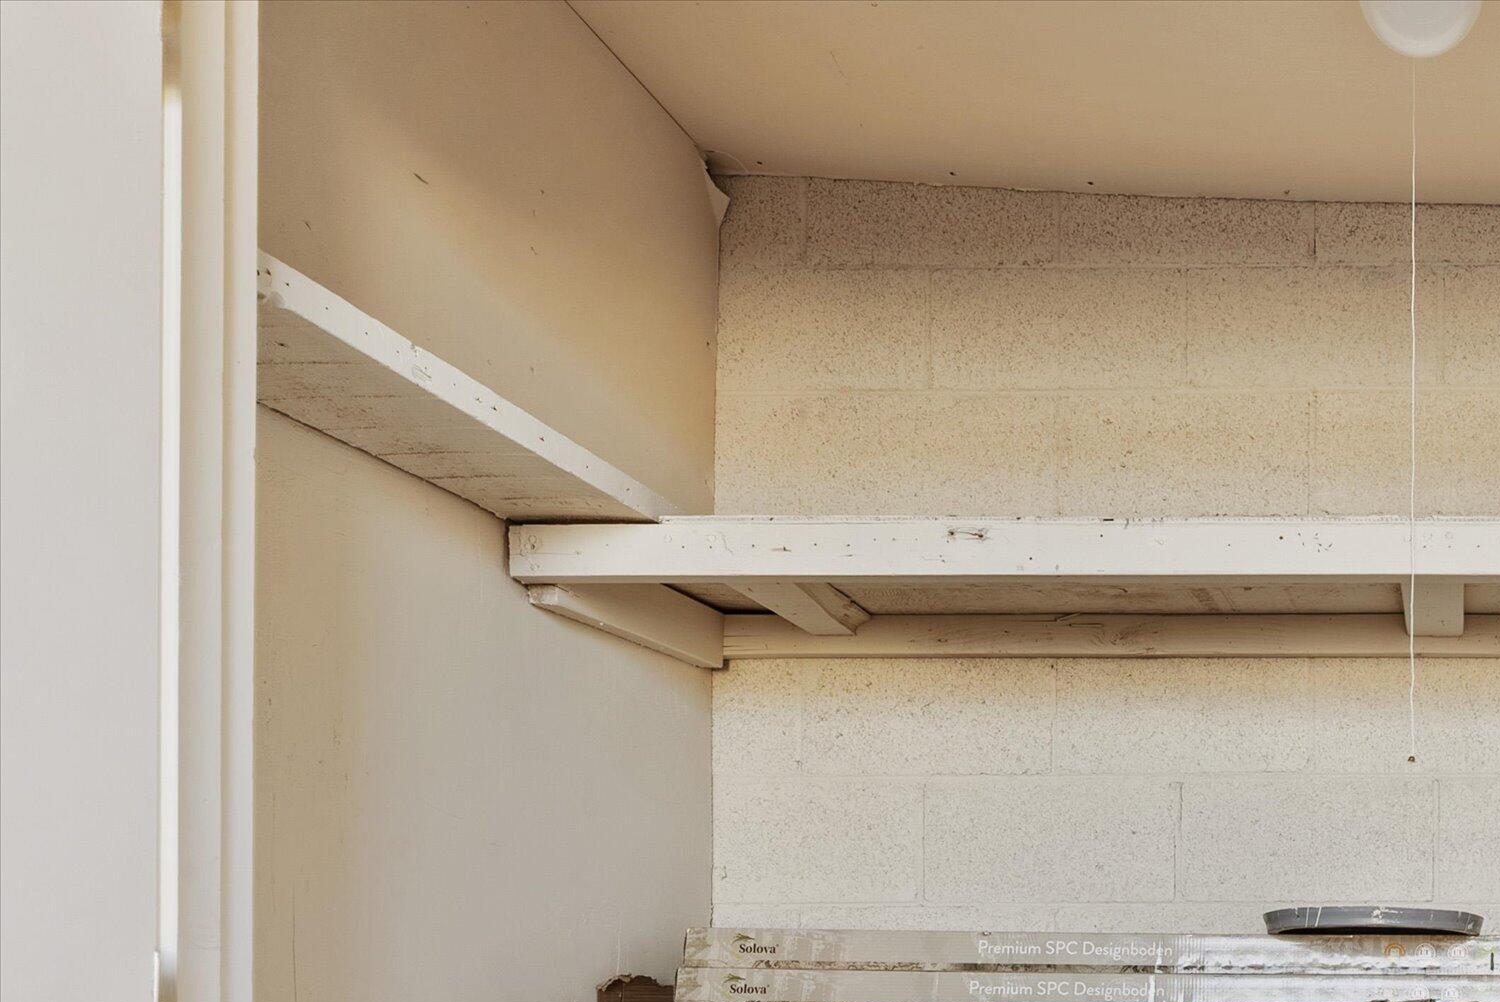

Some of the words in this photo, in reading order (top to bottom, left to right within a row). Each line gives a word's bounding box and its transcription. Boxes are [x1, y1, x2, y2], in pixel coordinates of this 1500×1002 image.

[738, 943, 776, 954] Solova
[978, 940, 1041, 956] Premium
[1046, 941, 1078, 955] SPC
[729, 983, 767, 994] Solova
[969, 981, 1033, 995] Premium
[1037, 982, 1069, 996] SPC
[1074, 982, 1165, 1001] Designbodn
